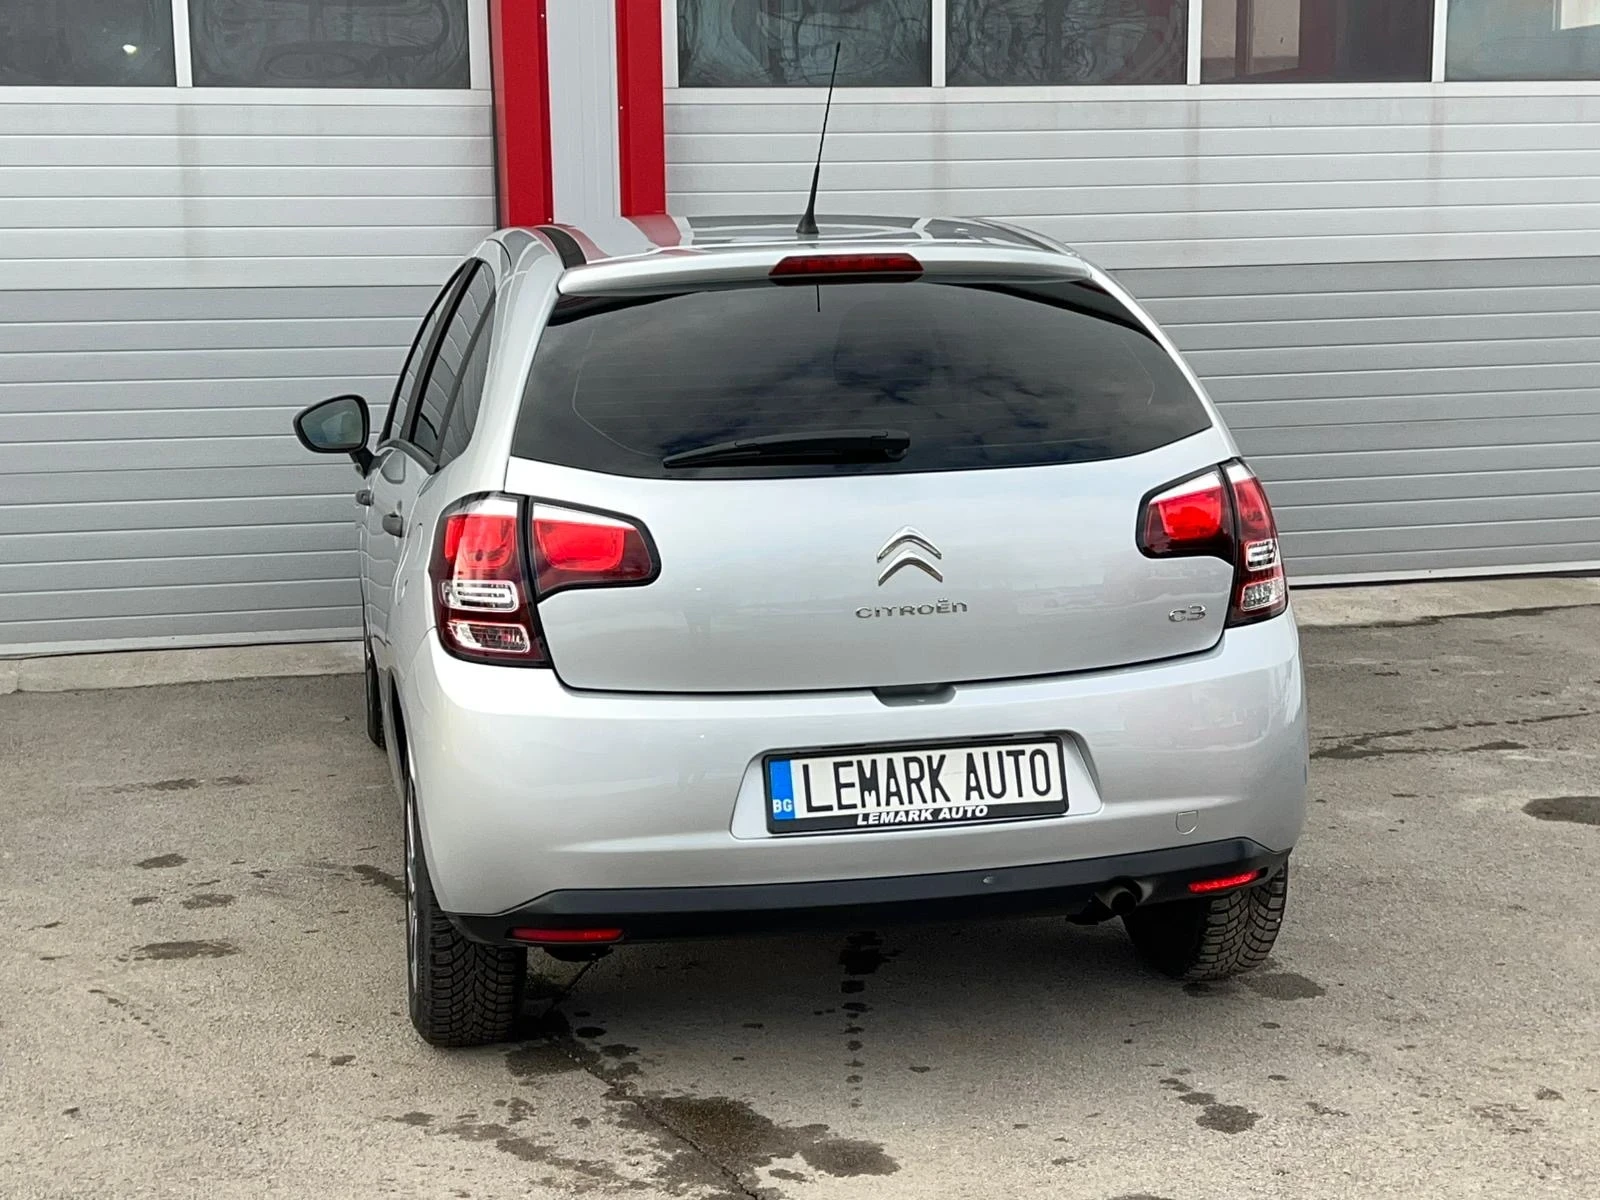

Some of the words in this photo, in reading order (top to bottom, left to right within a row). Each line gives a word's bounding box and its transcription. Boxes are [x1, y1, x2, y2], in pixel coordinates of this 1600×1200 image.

[1168, 605, 1206, 622] C3
[802, 754, 951, 813] LEMARK
[965, 748, 1051, 801] AUTO
[772, 798, 793, 813] BG
[856, 808, 933, 826] LEMARK
[938, 804, 988, 820] AUTO
